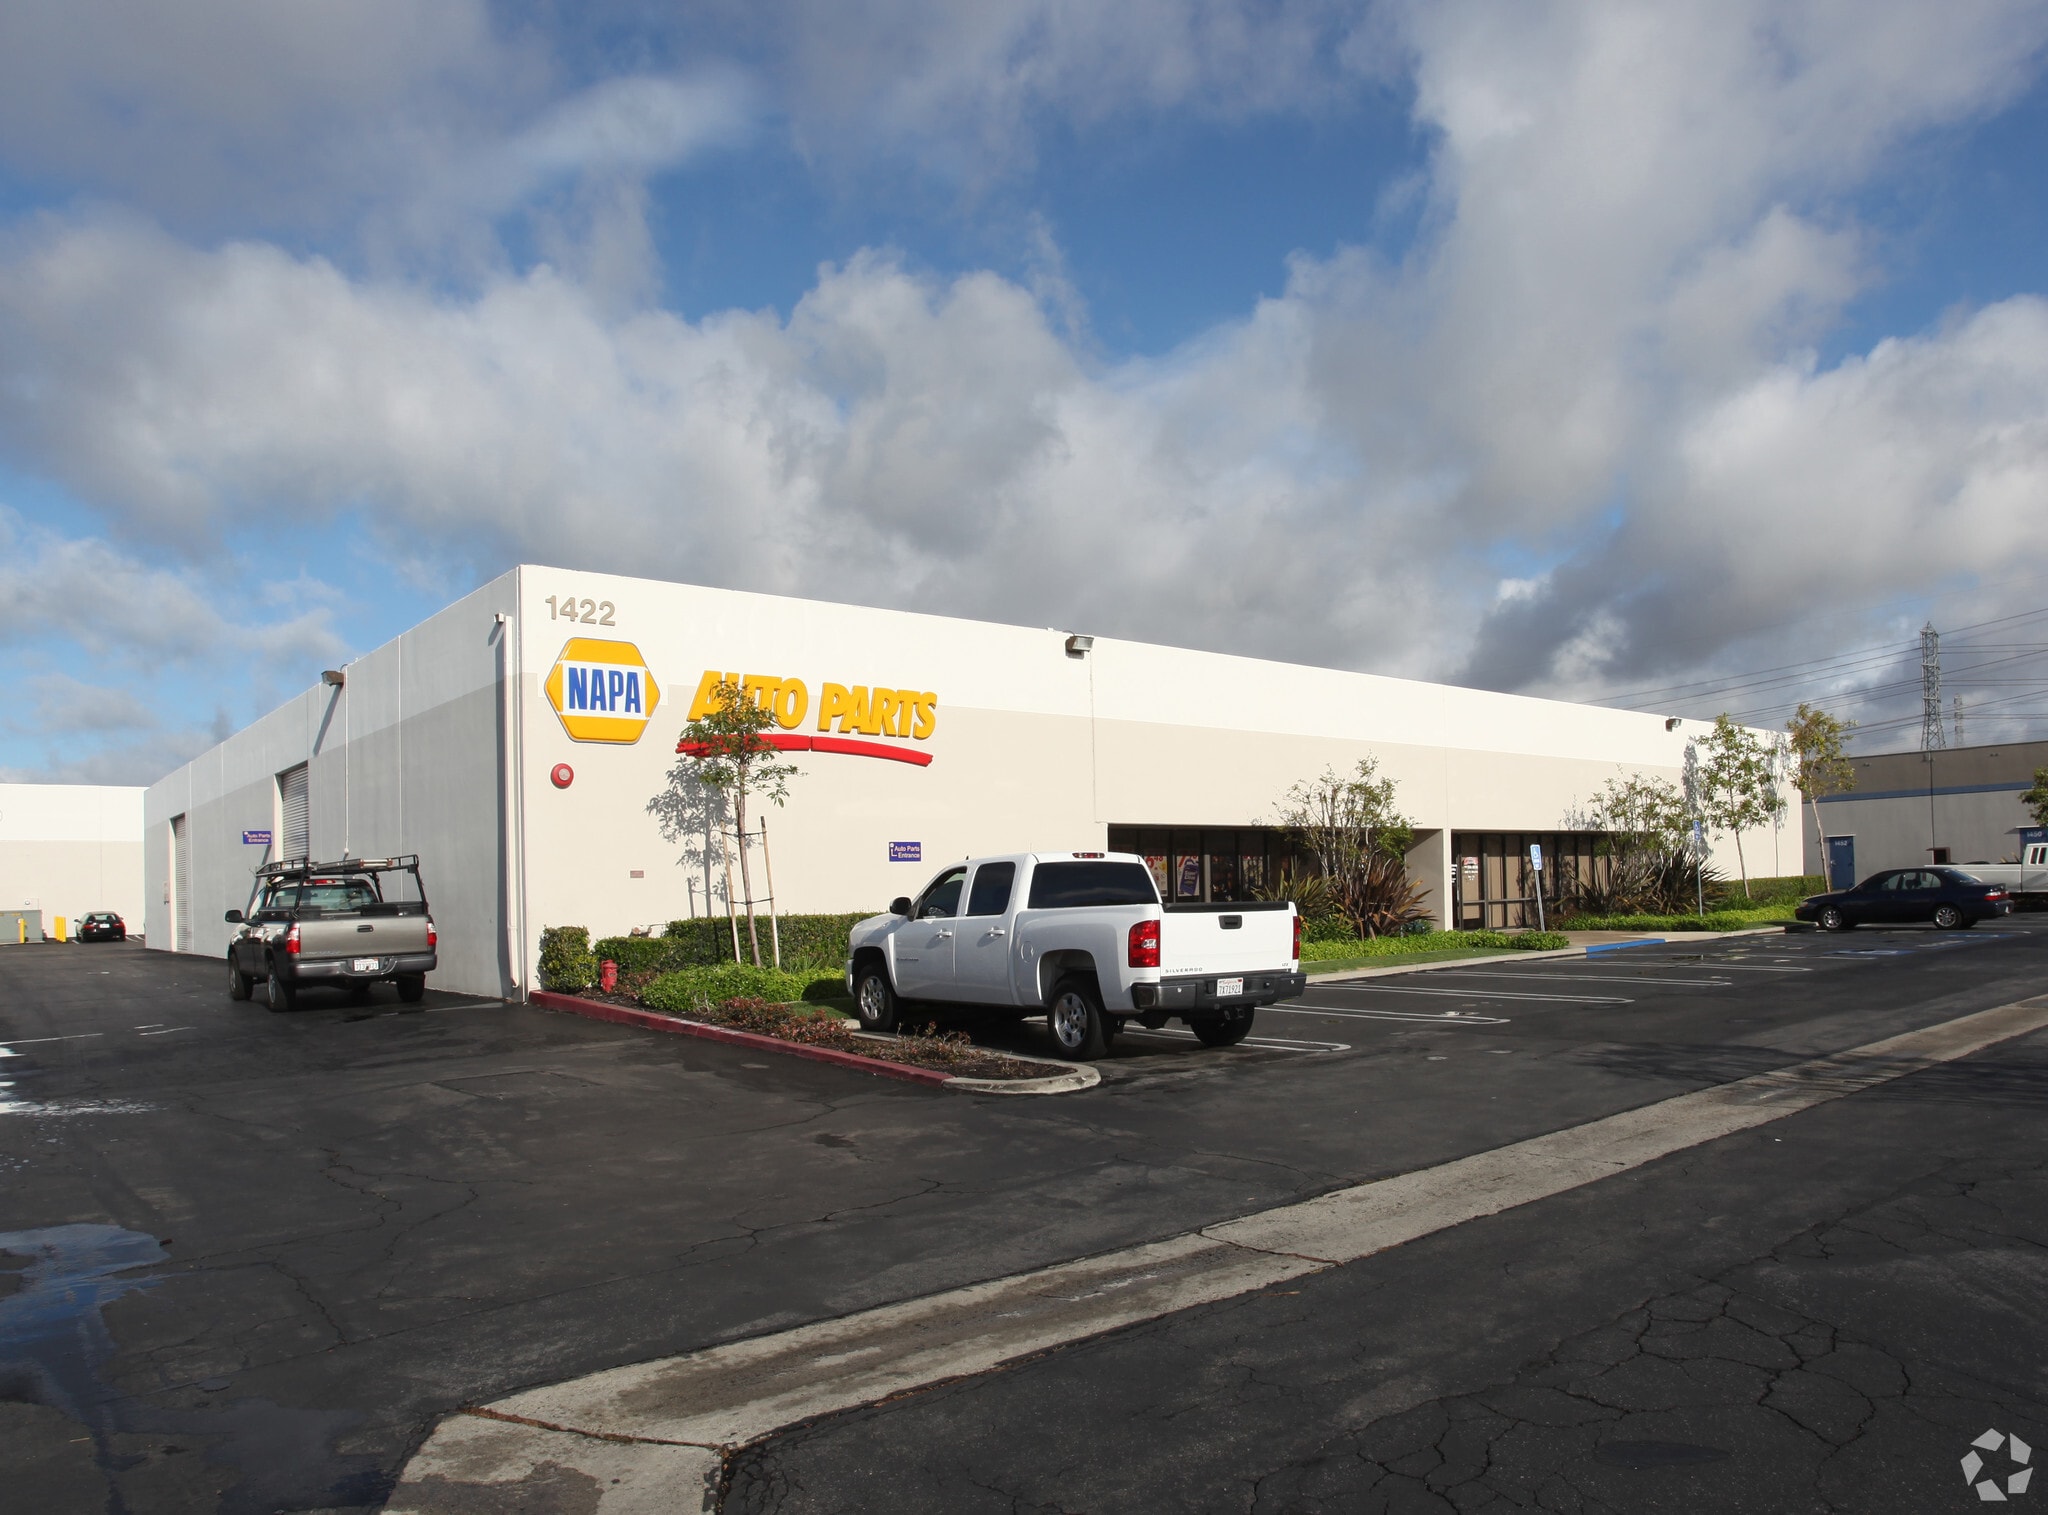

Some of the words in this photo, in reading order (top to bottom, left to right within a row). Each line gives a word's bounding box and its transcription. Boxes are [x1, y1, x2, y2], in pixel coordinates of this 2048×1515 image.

[545, 595, 616, 626] 1422
[568, 667, 641, 713] NAPA
[687, 670, 808, 730] AUTO
[817, 682, 937, 740] PARTS
